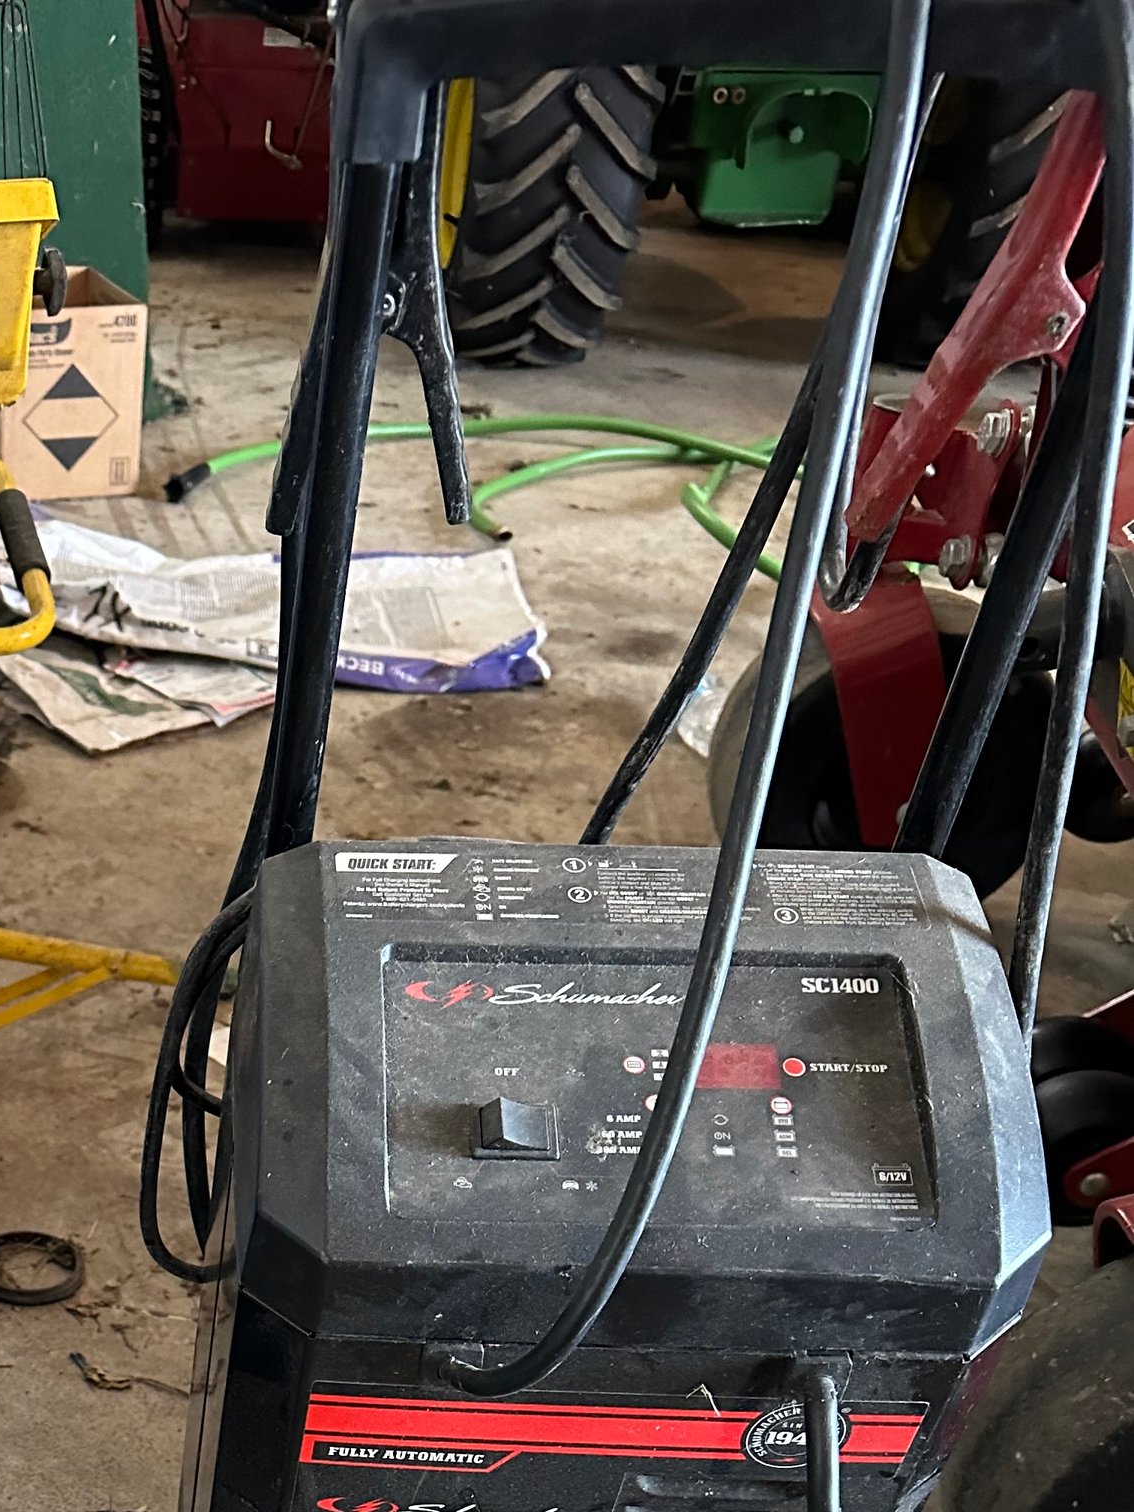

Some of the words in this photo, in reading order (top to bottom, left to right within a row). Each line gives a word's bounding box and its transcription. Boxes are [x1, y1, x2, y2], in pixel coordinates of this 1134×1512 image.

[348, 858, 388, 869] QUICK
[392, 859, 437, 870] START:
[569, 860, 577, 870] 1
[574, 889, 585, 899] 2
[781, 911, 791, 921] 3
[801, 978, 880, 994] SC1400
[489, 982, 685, 1005] Schumacher
[494, 1068, 520, 1076] OFF
[810, 1063, 888, 1073] START/STOP
[616, 1115, 642, 1123] AMP
[619, 1130, 643, 1139] AMP
[879, 1171, 907, 1182] 6/12V
[781, 1421, 804, 1430] SIN
[750, 1407, 802, 1457] SCHUMACHER
[765, 1431, 807, 1446] 194
[328, 1446, 378, 1459] FULLY
[383, 1449, 485, 1464] AUTOMATIC
